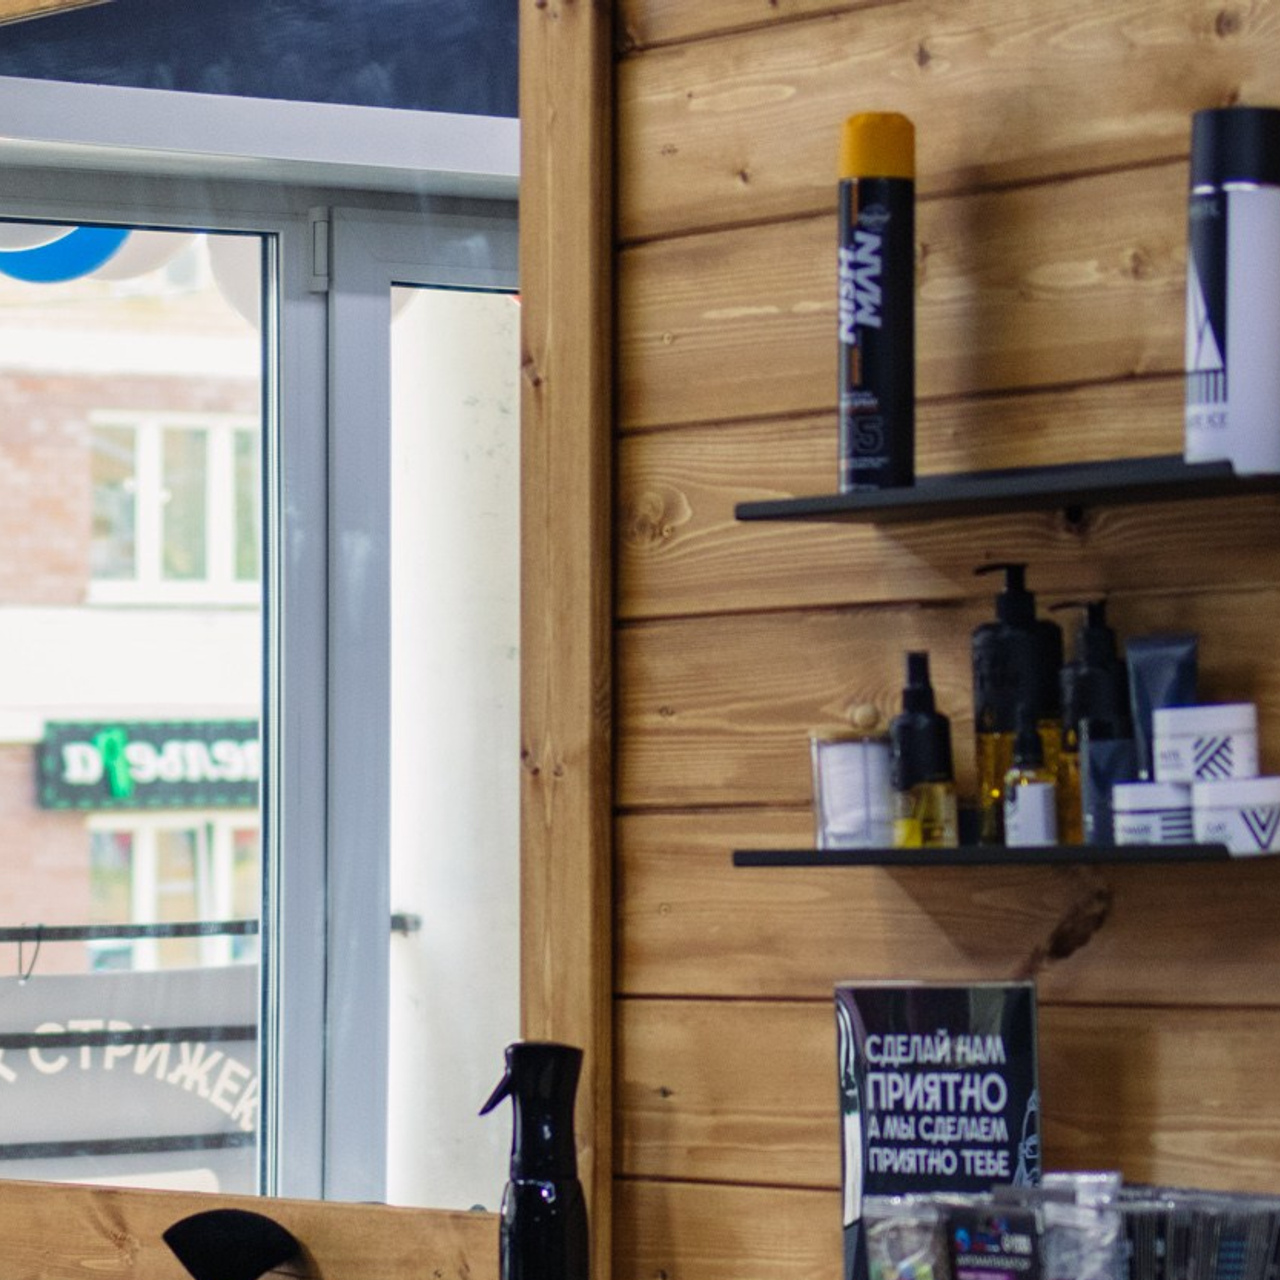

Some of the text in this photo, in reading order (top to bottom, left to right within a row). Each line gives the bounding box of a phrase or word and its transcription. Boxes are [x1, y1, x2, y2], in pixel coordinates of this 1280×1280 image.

[854, 231, 882, 328] MAN
[865, 1029, 1006, 1067] СДЕЛАЙ НАМ
[866, 1072, 1008, 1113] ПРИЯТНО
[867, 1114, 1009, 1145] А МЫ СДЕЛАЕМ
[869, 1147, 1011, 1177] ПРИЯТНО ТЕБЕ
